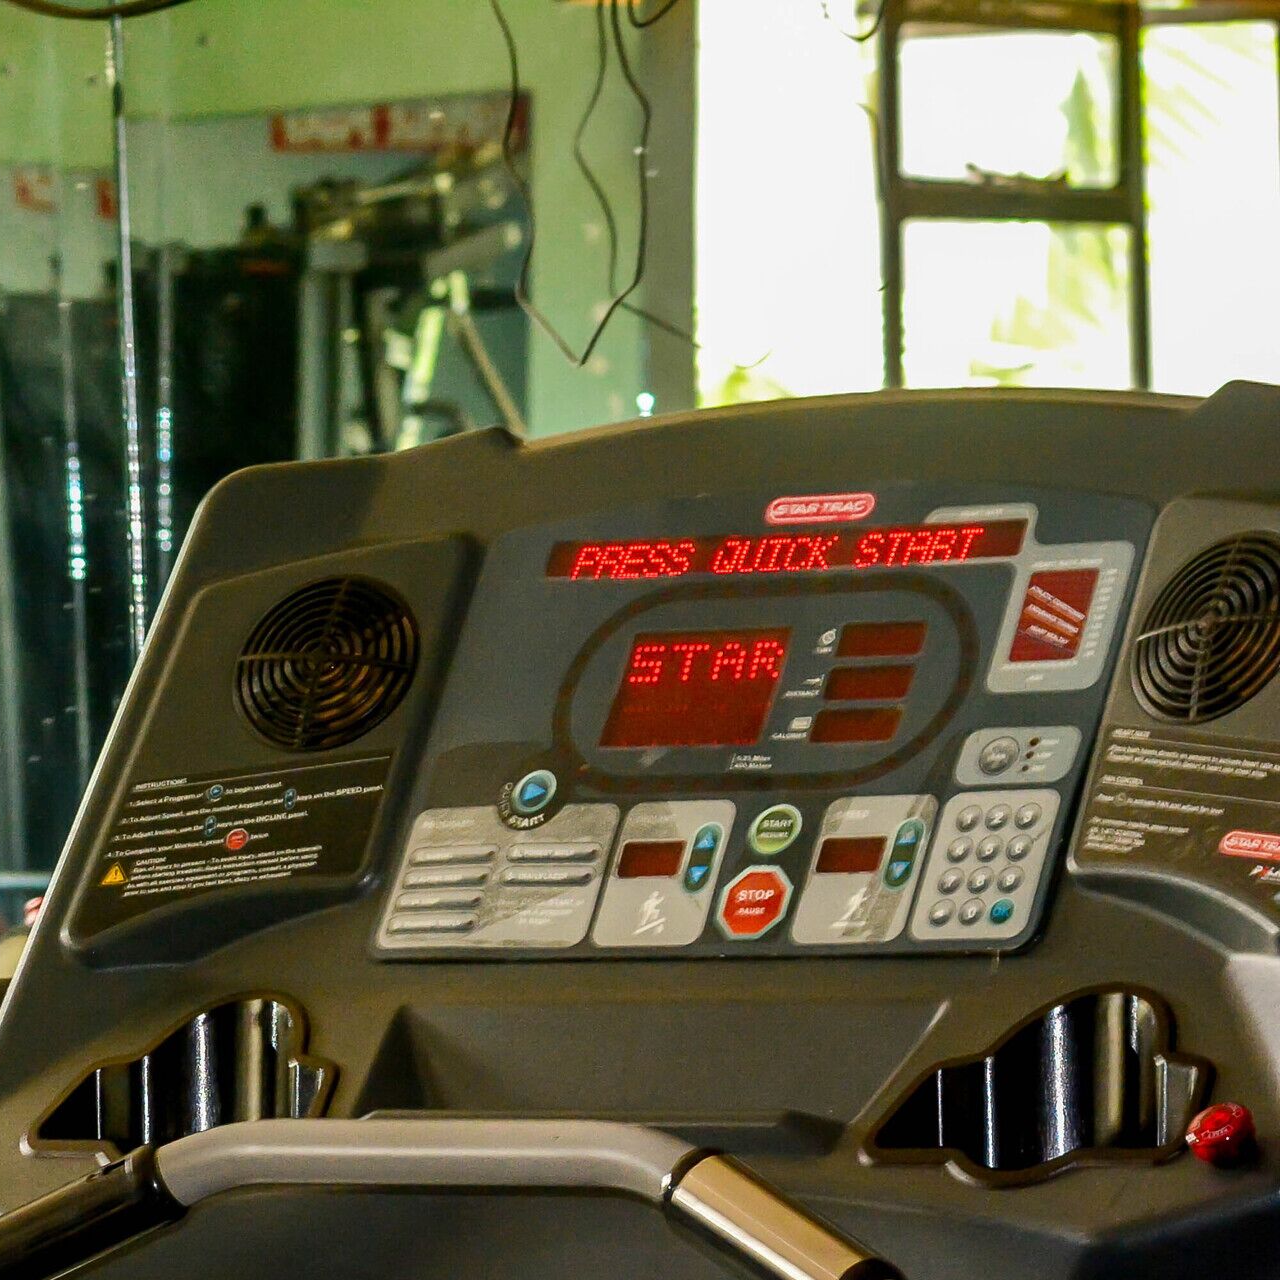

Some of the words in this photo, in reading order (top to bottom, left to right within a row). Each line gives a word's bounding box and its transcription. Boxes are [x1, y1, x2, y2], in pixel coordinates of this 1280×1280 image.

[772, 502, 822, 516] STAR
[822, 499, 867, 514] TRAC
[570, 541, 696, 581] PRESS
[711, 535, 841, 576] QUICK
[855, 526, 985, 570] START
[627, 640, 785, 684] STAR
[509, 814, 546, 829] START
[762, 819, 794, 829] START
[736, 889, 775, 902] STOP
[737, 906, 767, 915] PAUSE
